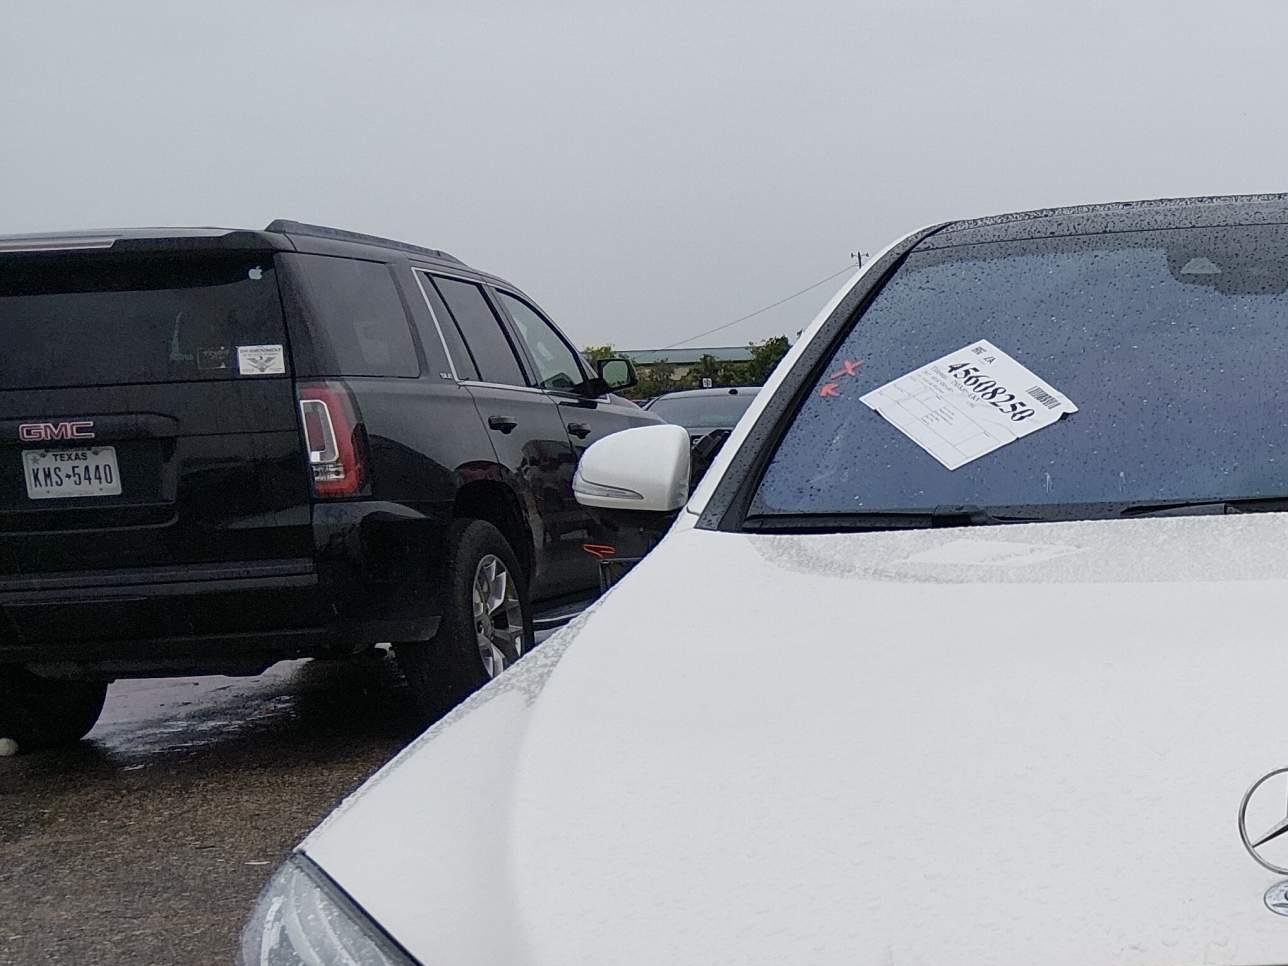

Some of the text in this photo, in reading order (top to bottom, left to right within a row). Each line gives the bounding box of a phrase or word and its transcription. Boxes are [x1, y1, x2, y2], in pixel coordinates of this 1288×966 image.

[948, 363, 1036, 421] 45608250
[18, 420, 95, 441] GMC
[52, 452, 88, 462] TEXAS
